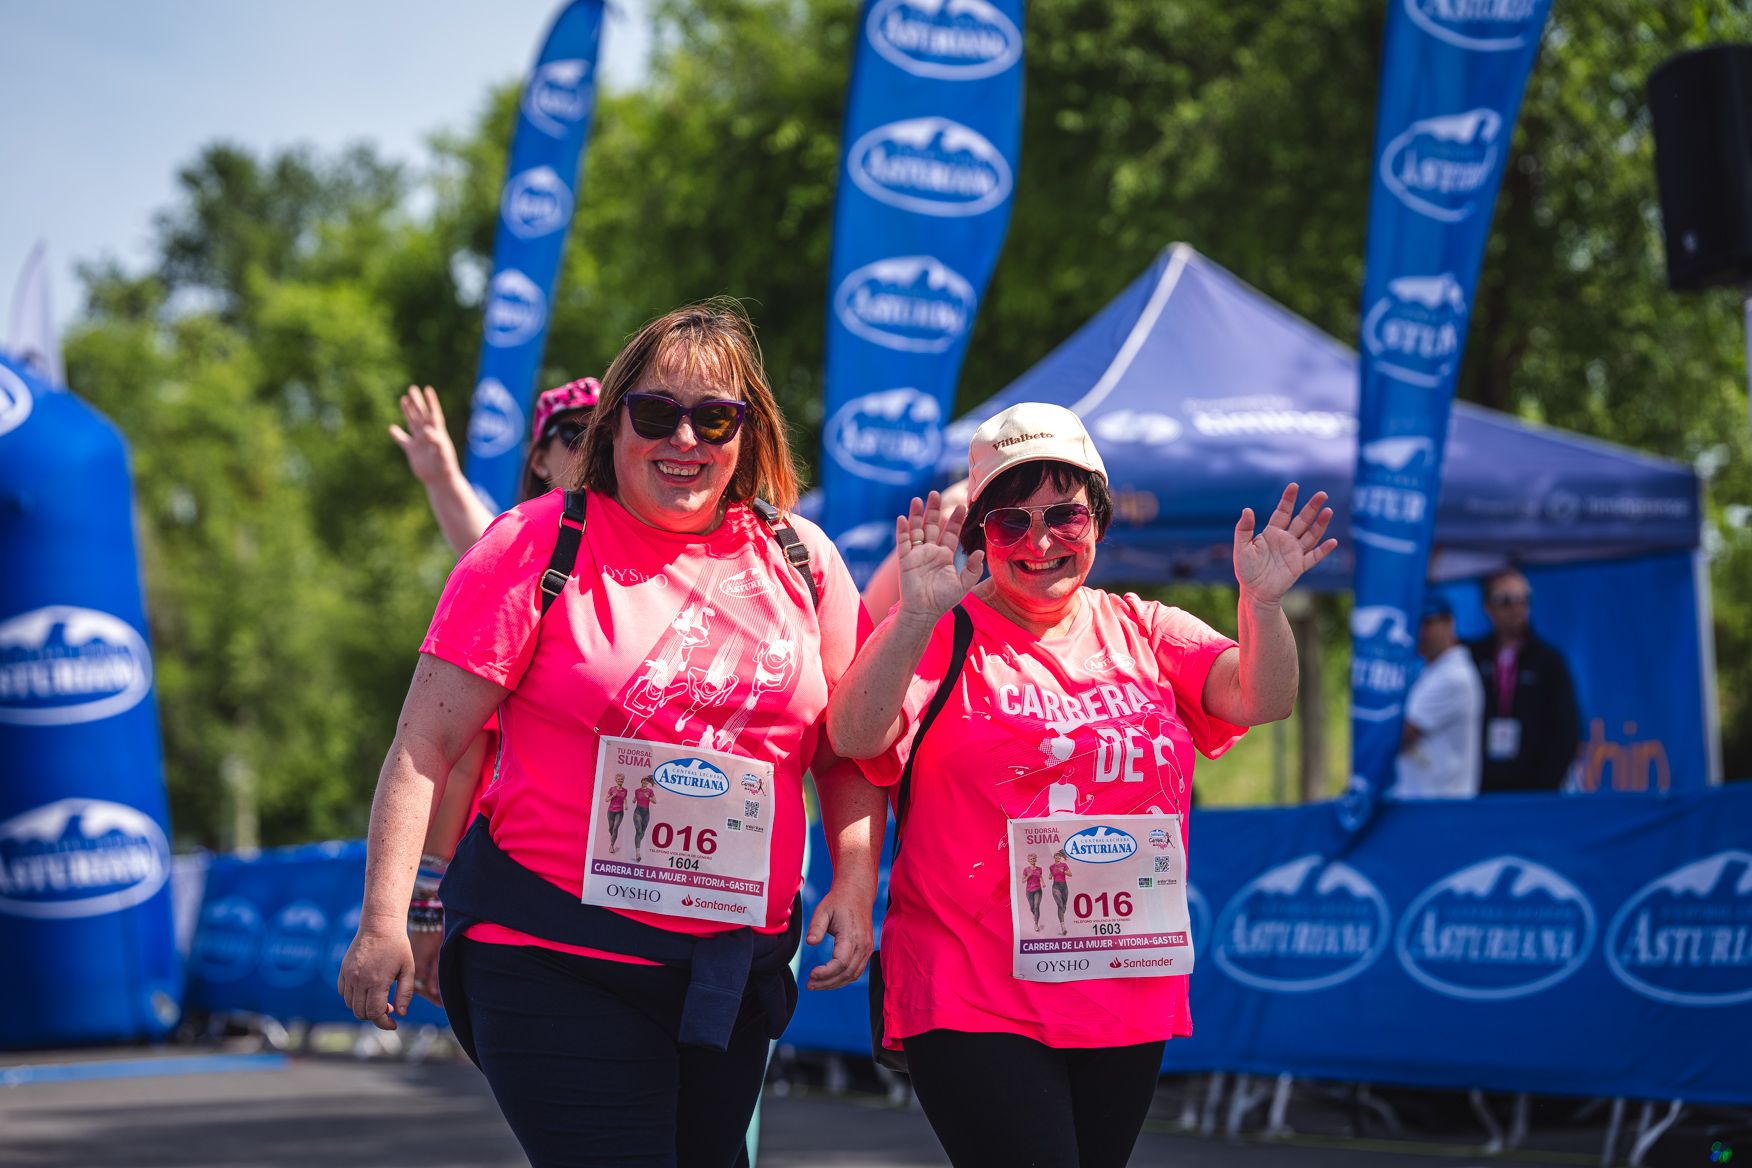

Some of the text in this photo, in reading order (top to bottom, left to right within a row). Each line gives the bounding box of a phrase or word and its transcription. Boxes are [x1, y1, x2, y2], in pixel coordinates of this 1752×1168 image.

[992, 432, 1054, 451] Villalbeto
[999, 681, 1150, 723] CARRERA
[617, 755, 651, 768] SUMA
[626, 749, 652, 757] DORSAL
[1092, 727, 1145, 783] DE
[659, 767, 724, 791] ASTURIANA
[672, 768, 697, 776] CENTRAL
[651, 822, 718, 855] 016
[1026, 834, 1060, 844] SUMA
[1070, 840, 1132, 855] ASTURIANA
[668, 856, 699, 871] 1604
[594, 863, 632, 876] CARRERA
[634, 868, 644, 877] DE
[646, 870, 657, 879] LA
[659, 871, 687, 883] MUJER
[606, 883, 661, 903] OYSHO
[694, 897, 748, 914] Santander
[1073, 891, 1133, 919] 016
[1092, 923, 1121, 935] 1603
[1229, 912, 1371, 955] ASTURIANA
[1416, 909, 1577, 961] ASTURIANA
[1623, 910, 1752, 965] ASTURI
[1023, 943, 1060, 951] CARRERA
[1061, 942, 1072, 950] DE
[1073, 941, 1083, 949] LA
[1086, 940, 1113, 948] MUJER
[1036, 958, 1090, 973] OYSHO
[1123, 957, 1174, 969] Santander
